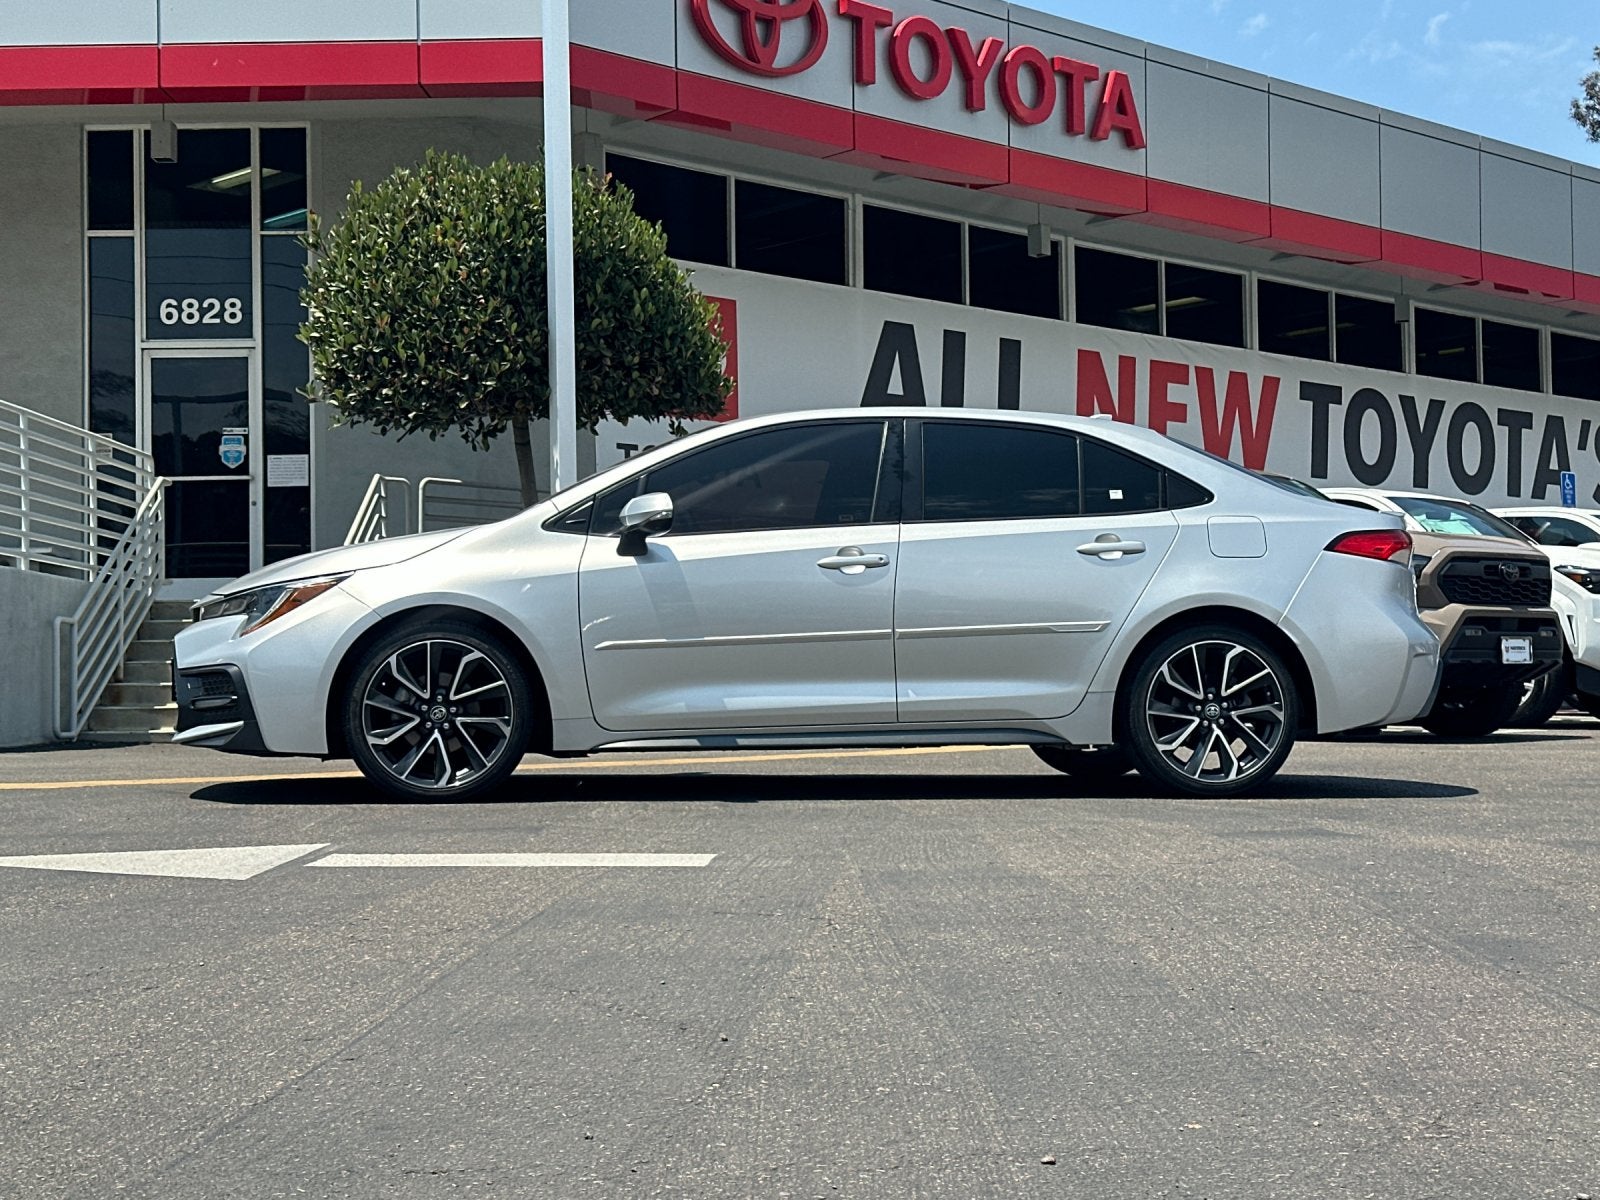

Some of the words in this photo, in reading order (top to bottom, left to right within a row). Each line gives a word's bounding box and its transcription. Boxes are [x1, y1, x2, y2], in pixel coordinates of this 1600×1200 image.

[838, 0, 1146, 149] TOYOTA
[160, 298, 243, 325] 6828
[1076, 348, 1281, 471] NEW
[1299, 380, 1600, 505] TOYOTA'
